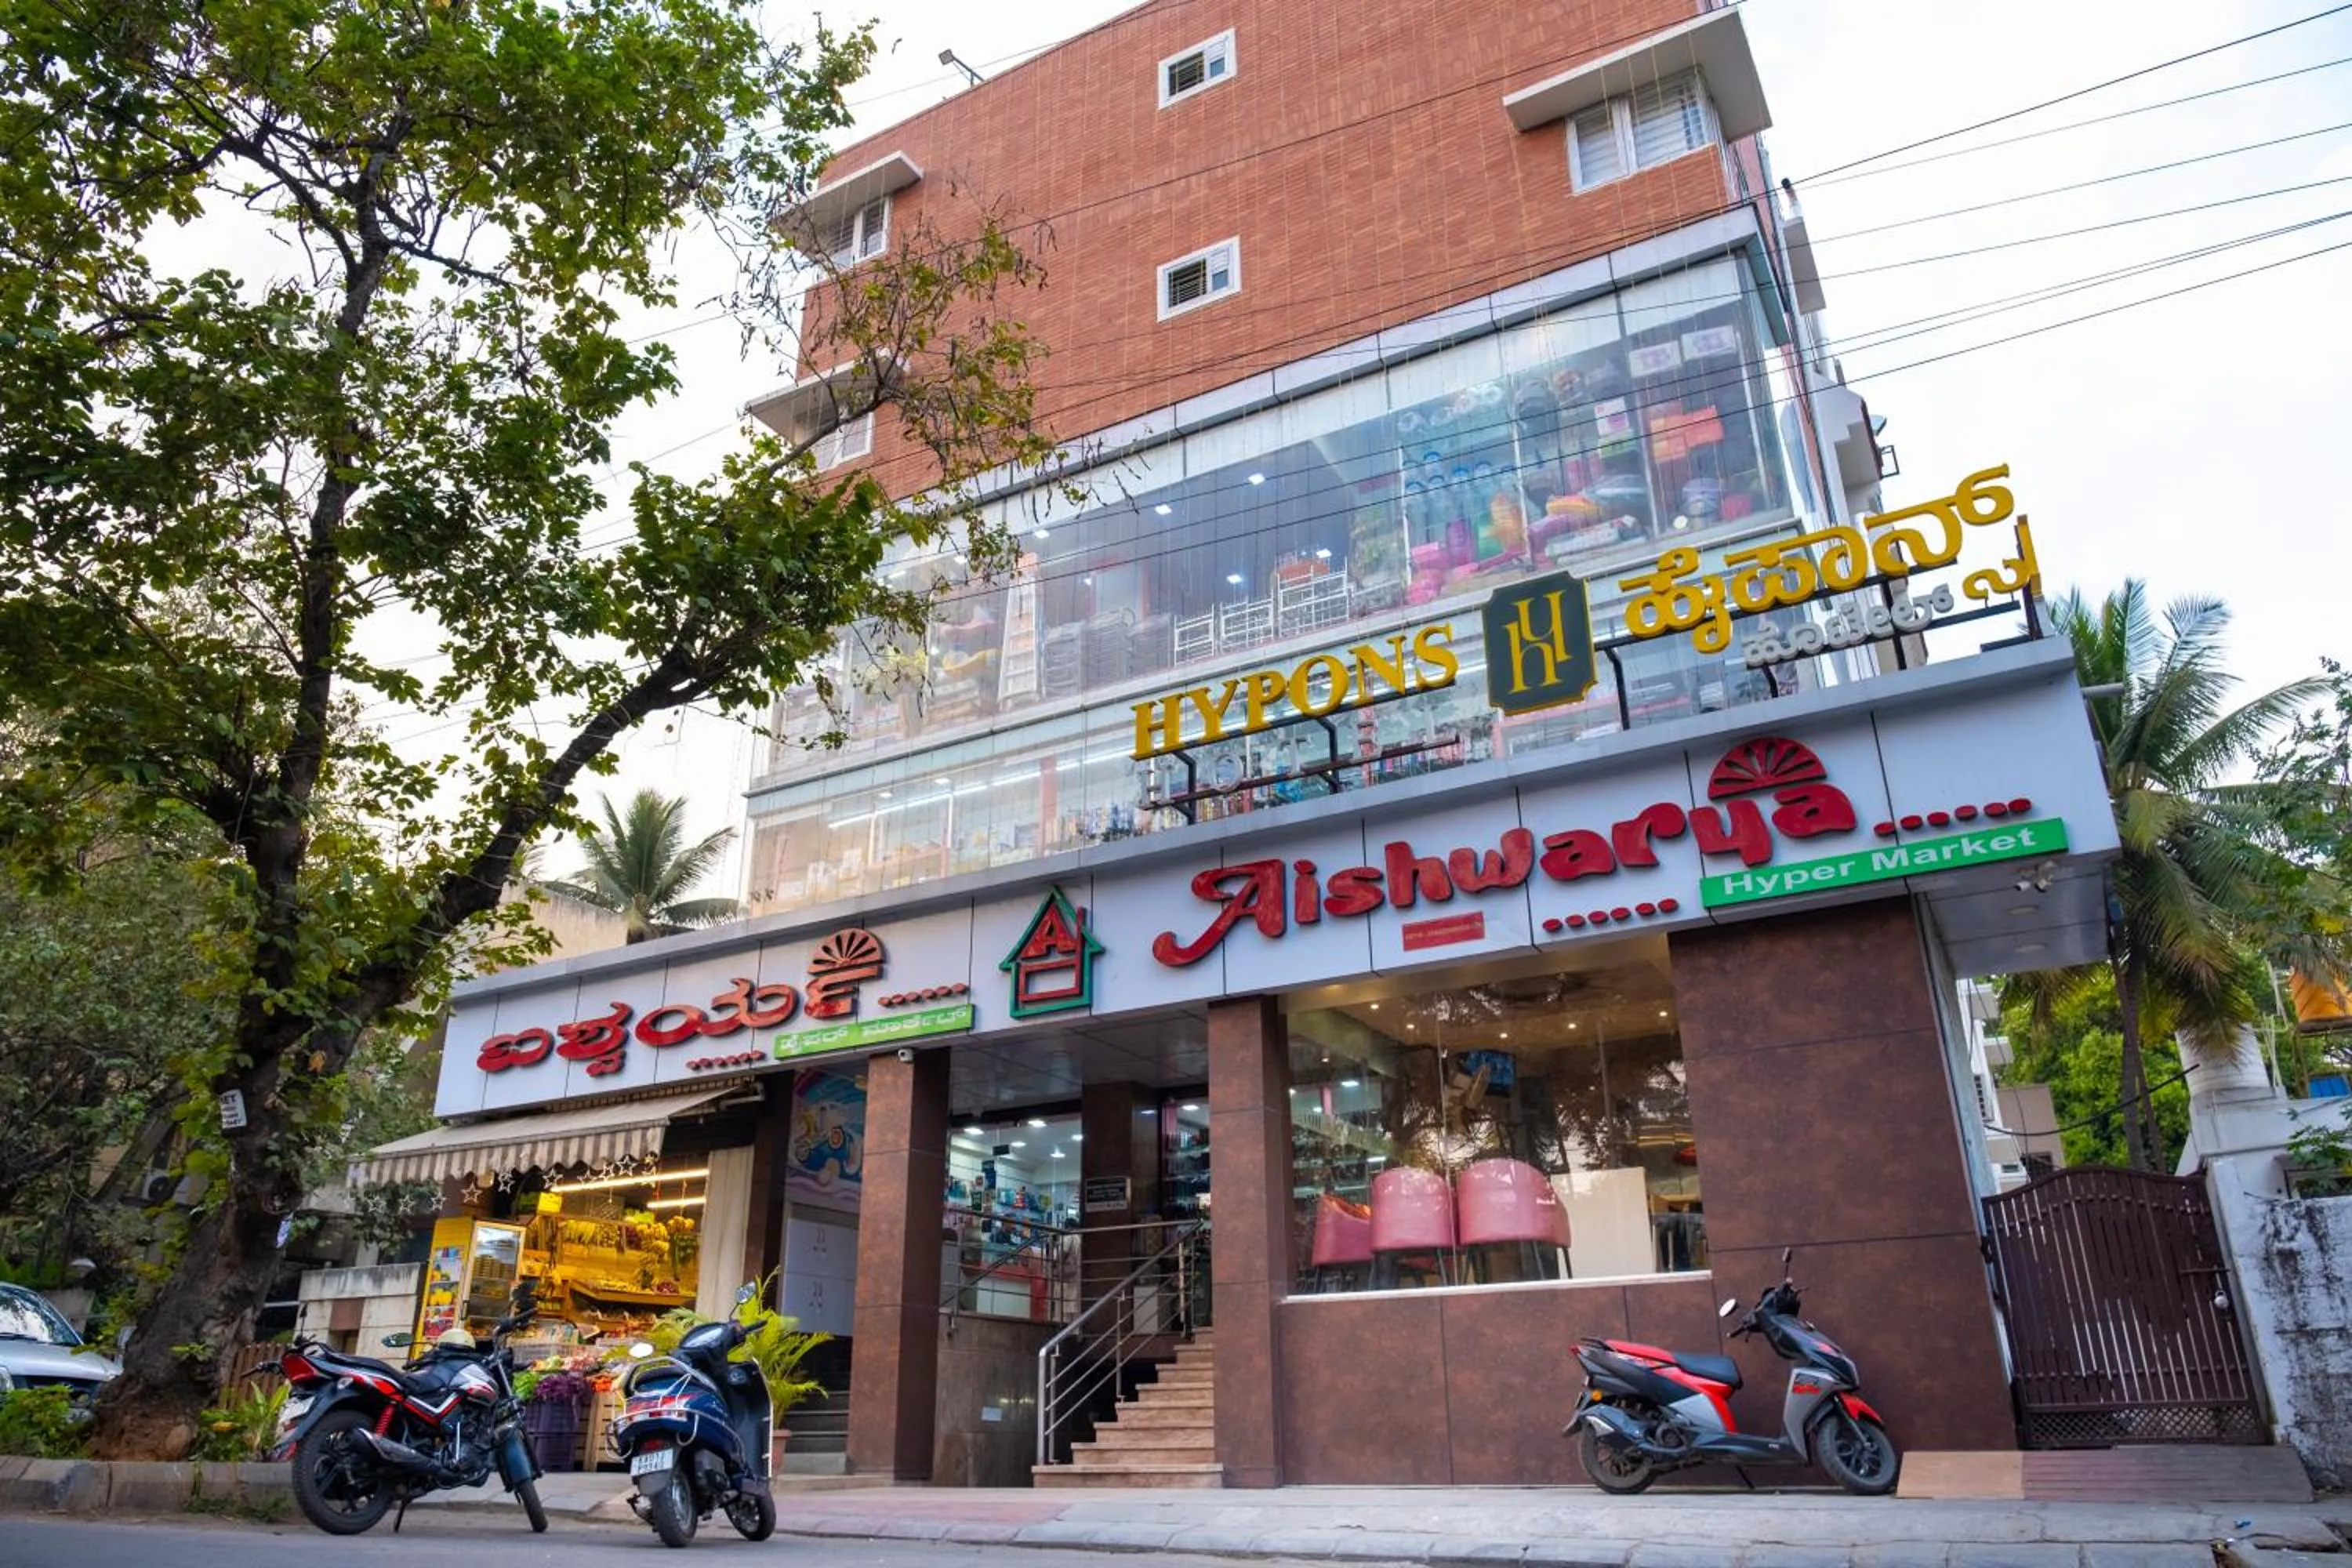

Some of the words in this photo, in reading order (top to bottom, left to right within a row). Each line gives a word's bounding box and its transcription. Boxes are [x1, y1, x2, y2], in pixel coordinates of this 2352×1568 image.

[1130, 622, 1460, 761] HYPONS
[1152, 782, 1857, 967] Aishwarya
[1724, 858, 1856, 895] Hyper
[1871, 826, 2036, 872] Market
